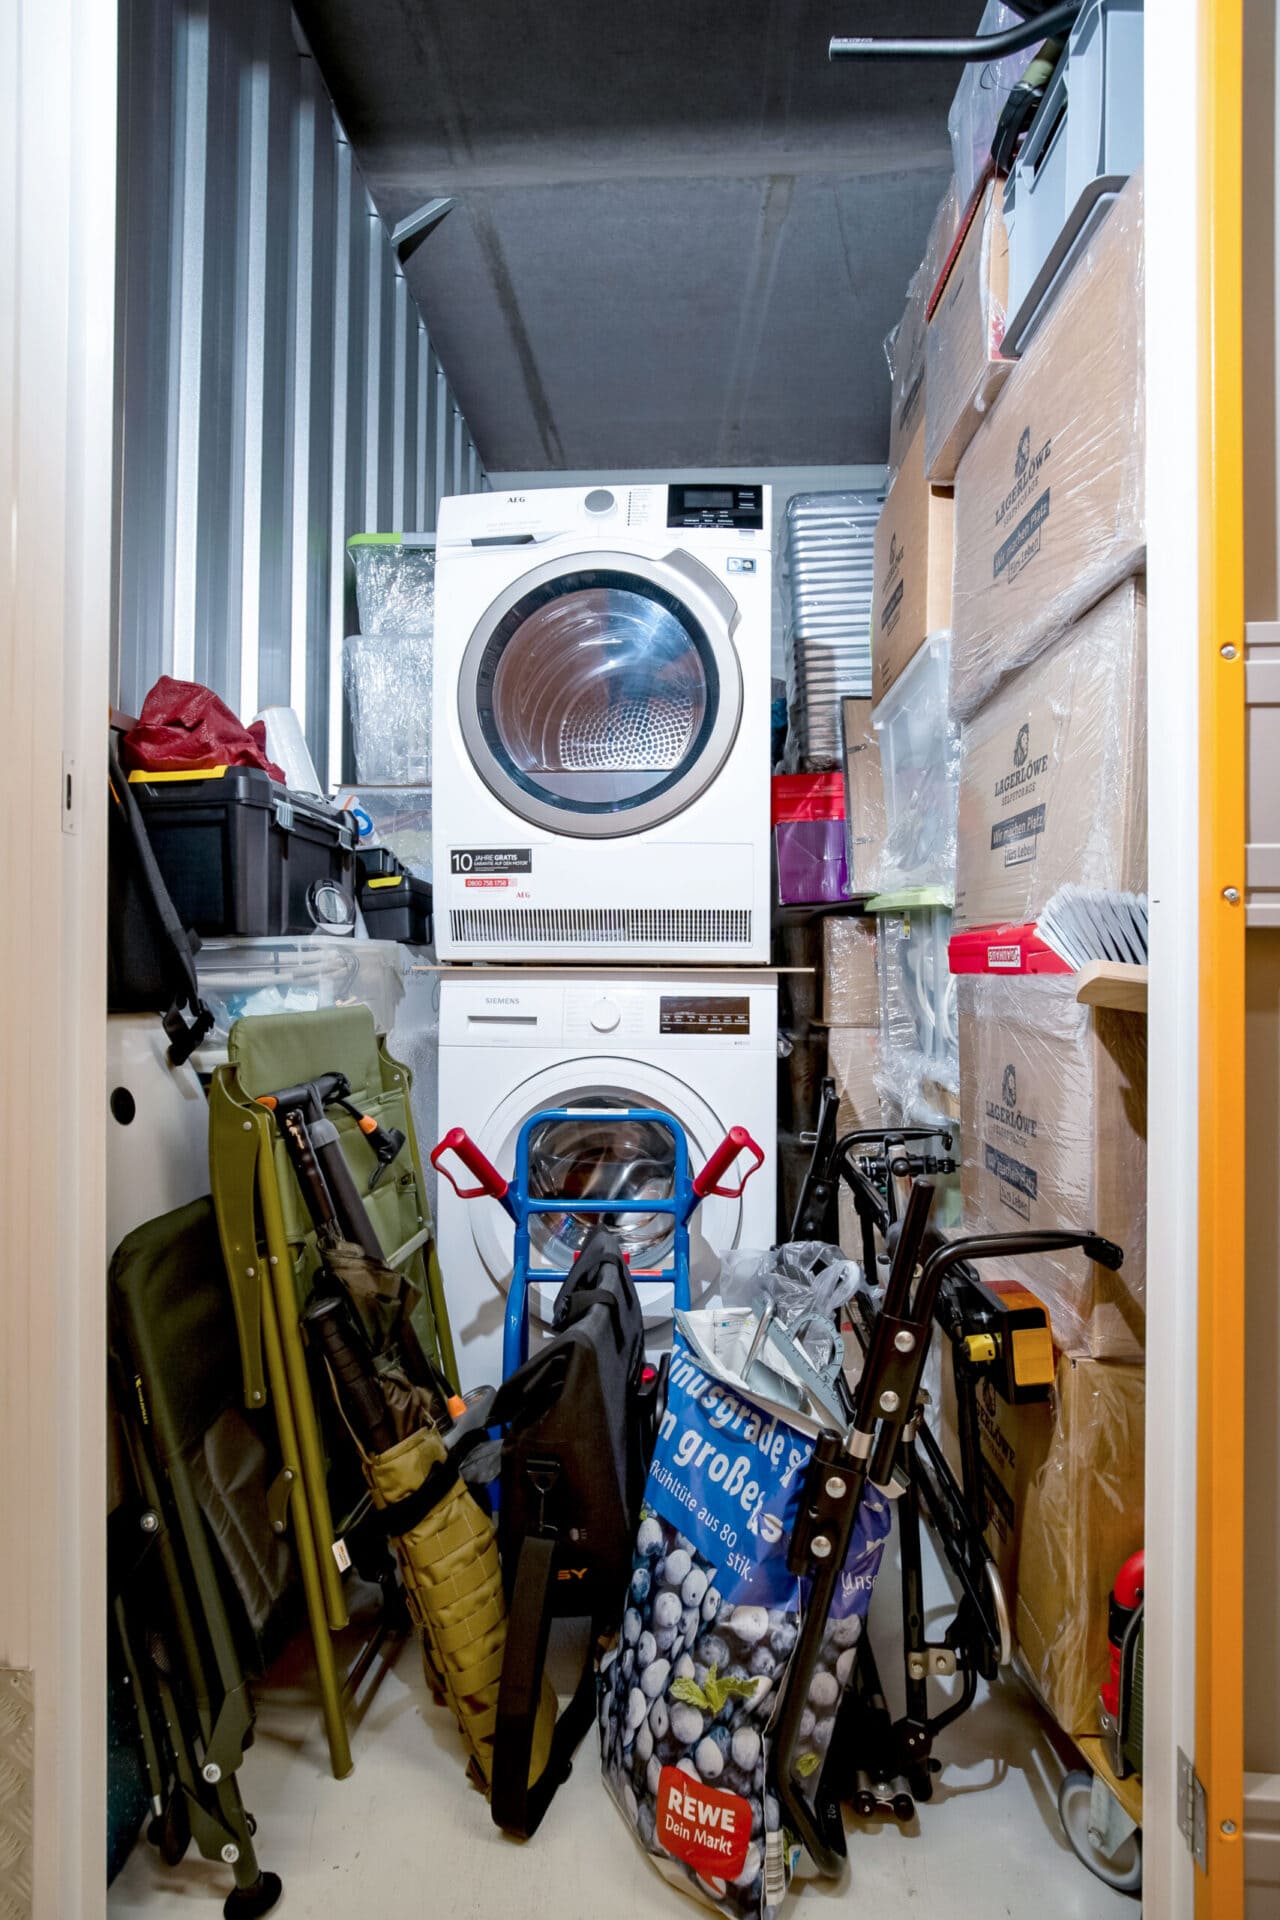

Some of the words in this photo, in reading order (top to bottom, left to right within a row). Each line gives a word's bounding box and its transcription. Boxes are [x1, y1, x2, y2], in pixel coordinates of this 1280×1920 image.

[995, 438, 1052, 527] LAGERLÖWE
[994, 754, 1048, 797] LAGERLÖWE
[1001, 781, 1037, 806] SELFSTORAGE
[1026, 812, 1043, 830] Platz
[452, 853, 473, 872] 10
[485, 997, 520, 1005] SIEMENS
[985, 1100, 1038, 1138] LAGERLÖWE
[697, 1505, 721, 1532] aus
[719, 1522, 738, 1549] 80
[557, 1567, 588, 1581] SY
[726, 1551, 753, 1582] stik.
[668, 1786, 736, 1834] REWE
[665, 1814, 690, 1841] Dein
[694, 1828, 733, 1857] Markt
